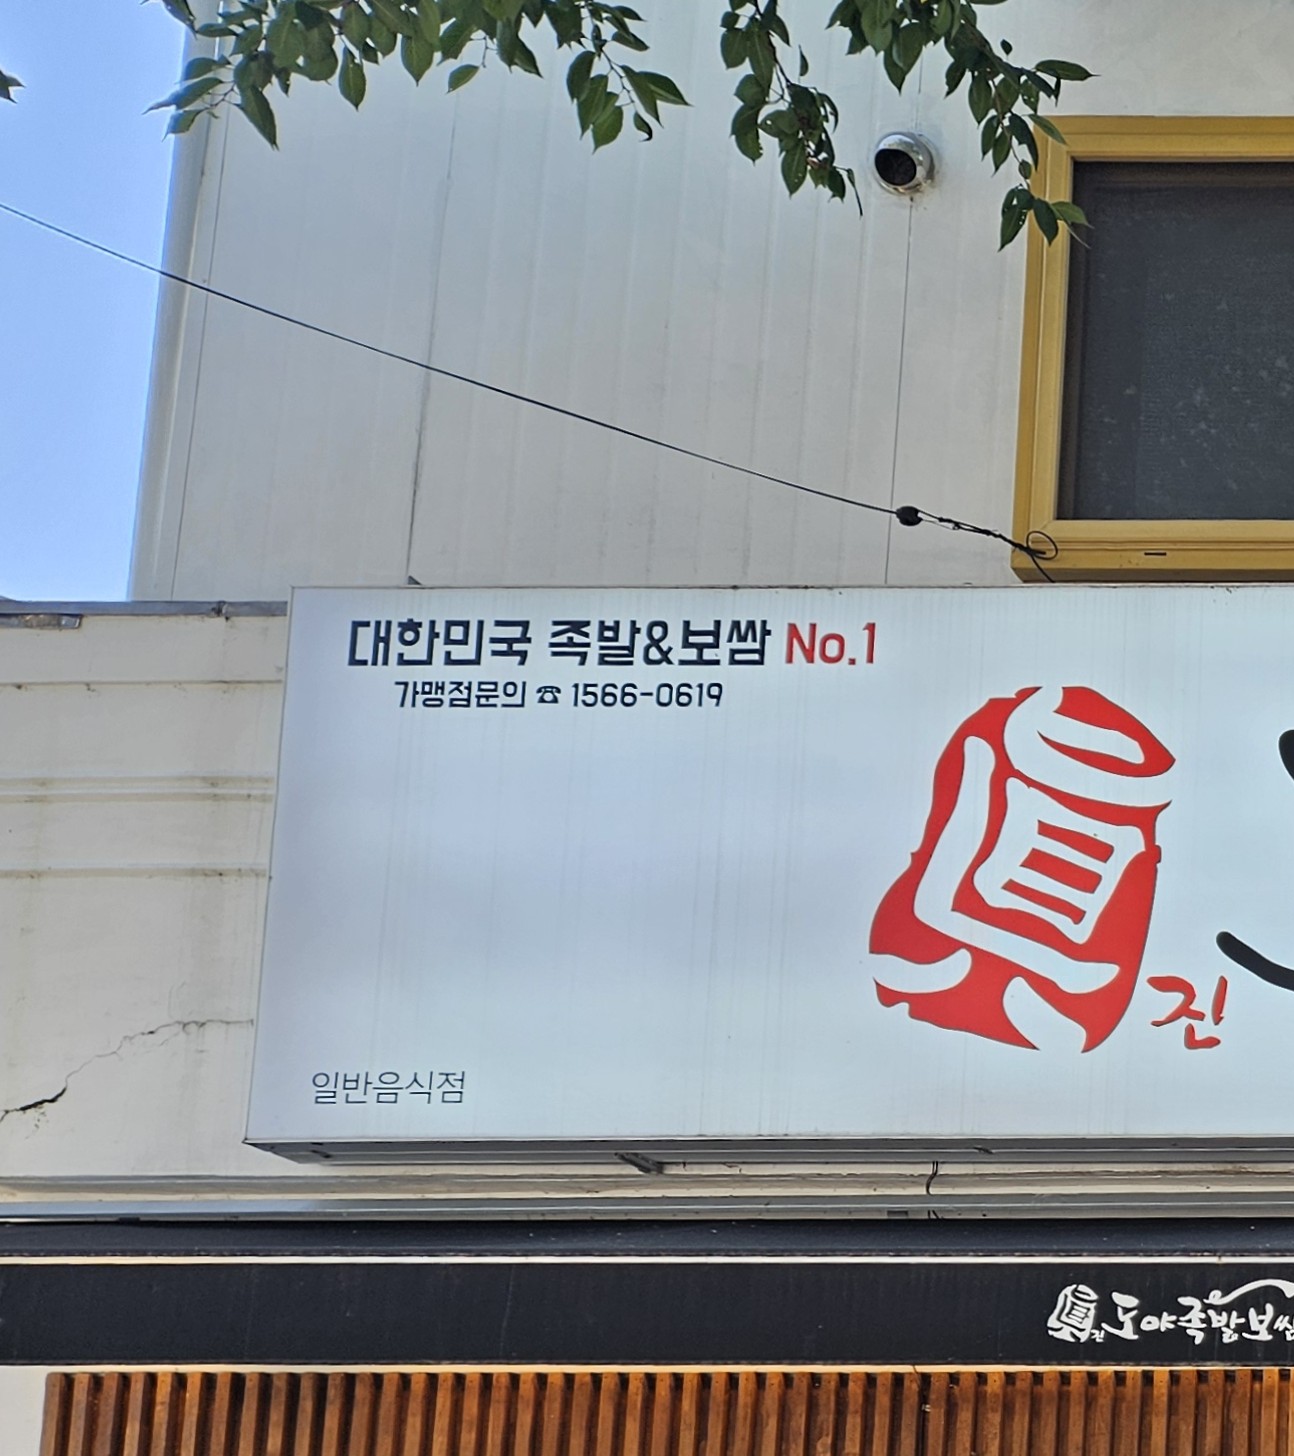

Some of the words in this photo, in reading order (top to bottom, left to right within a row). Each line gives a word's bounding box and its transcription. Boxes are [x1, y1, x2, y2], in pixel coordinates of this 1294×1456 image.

[347, 617, 532, 667] 대한민국
[547, 618, 771, 667] 족발&보쌈
[784, 622, 877, 666] No.1
[395, 679, 527, 709] 가맹점문의
[570, 681, 723, 709] 1566-0619
[1148, 974, 1227, 1051] 진
[310, 1070, 467, 1106] 일반음식점
